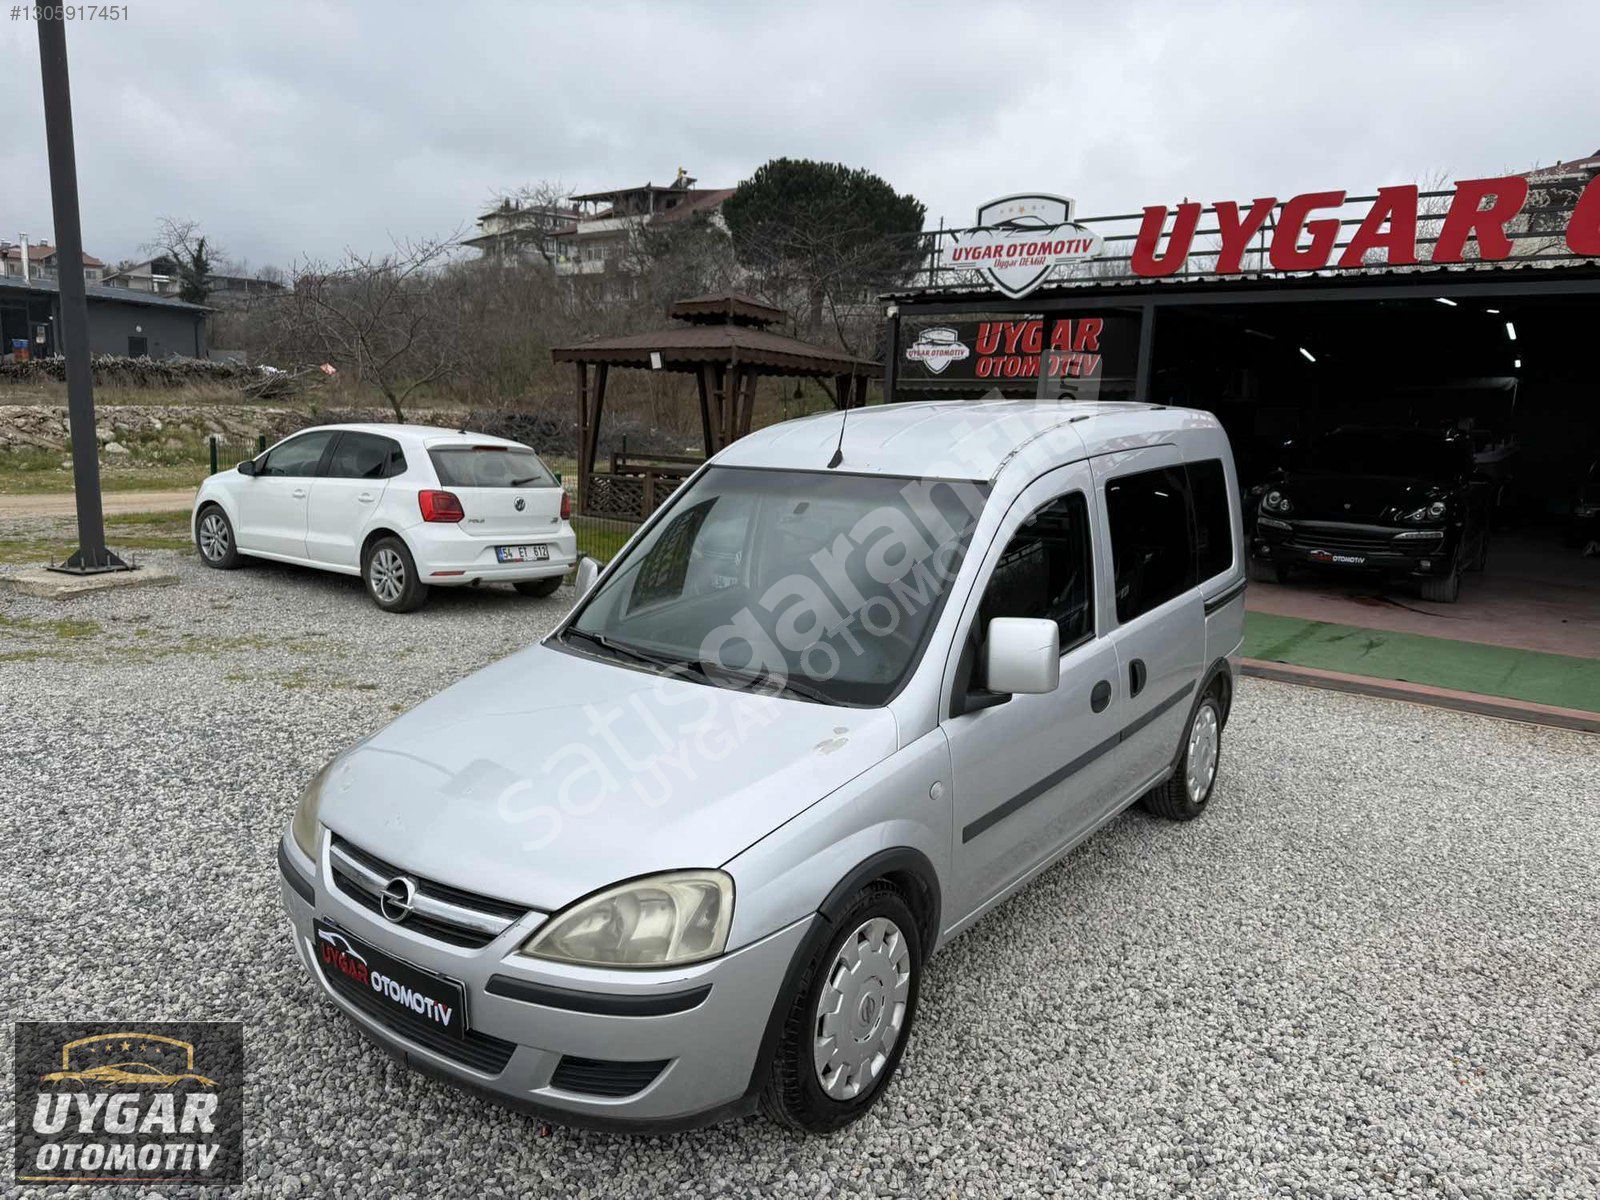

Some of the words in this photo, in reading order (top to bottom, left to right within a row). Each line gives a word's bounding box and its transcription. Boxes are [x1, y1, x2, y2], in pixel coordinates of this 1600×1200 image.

[1130, 176, 1529, 277] UYGAR
[952, 244, 1004, 262] UYGAR
[975, 318, 1103, 355] UYGAR
[320, 941, 368, 986] UYGAR
